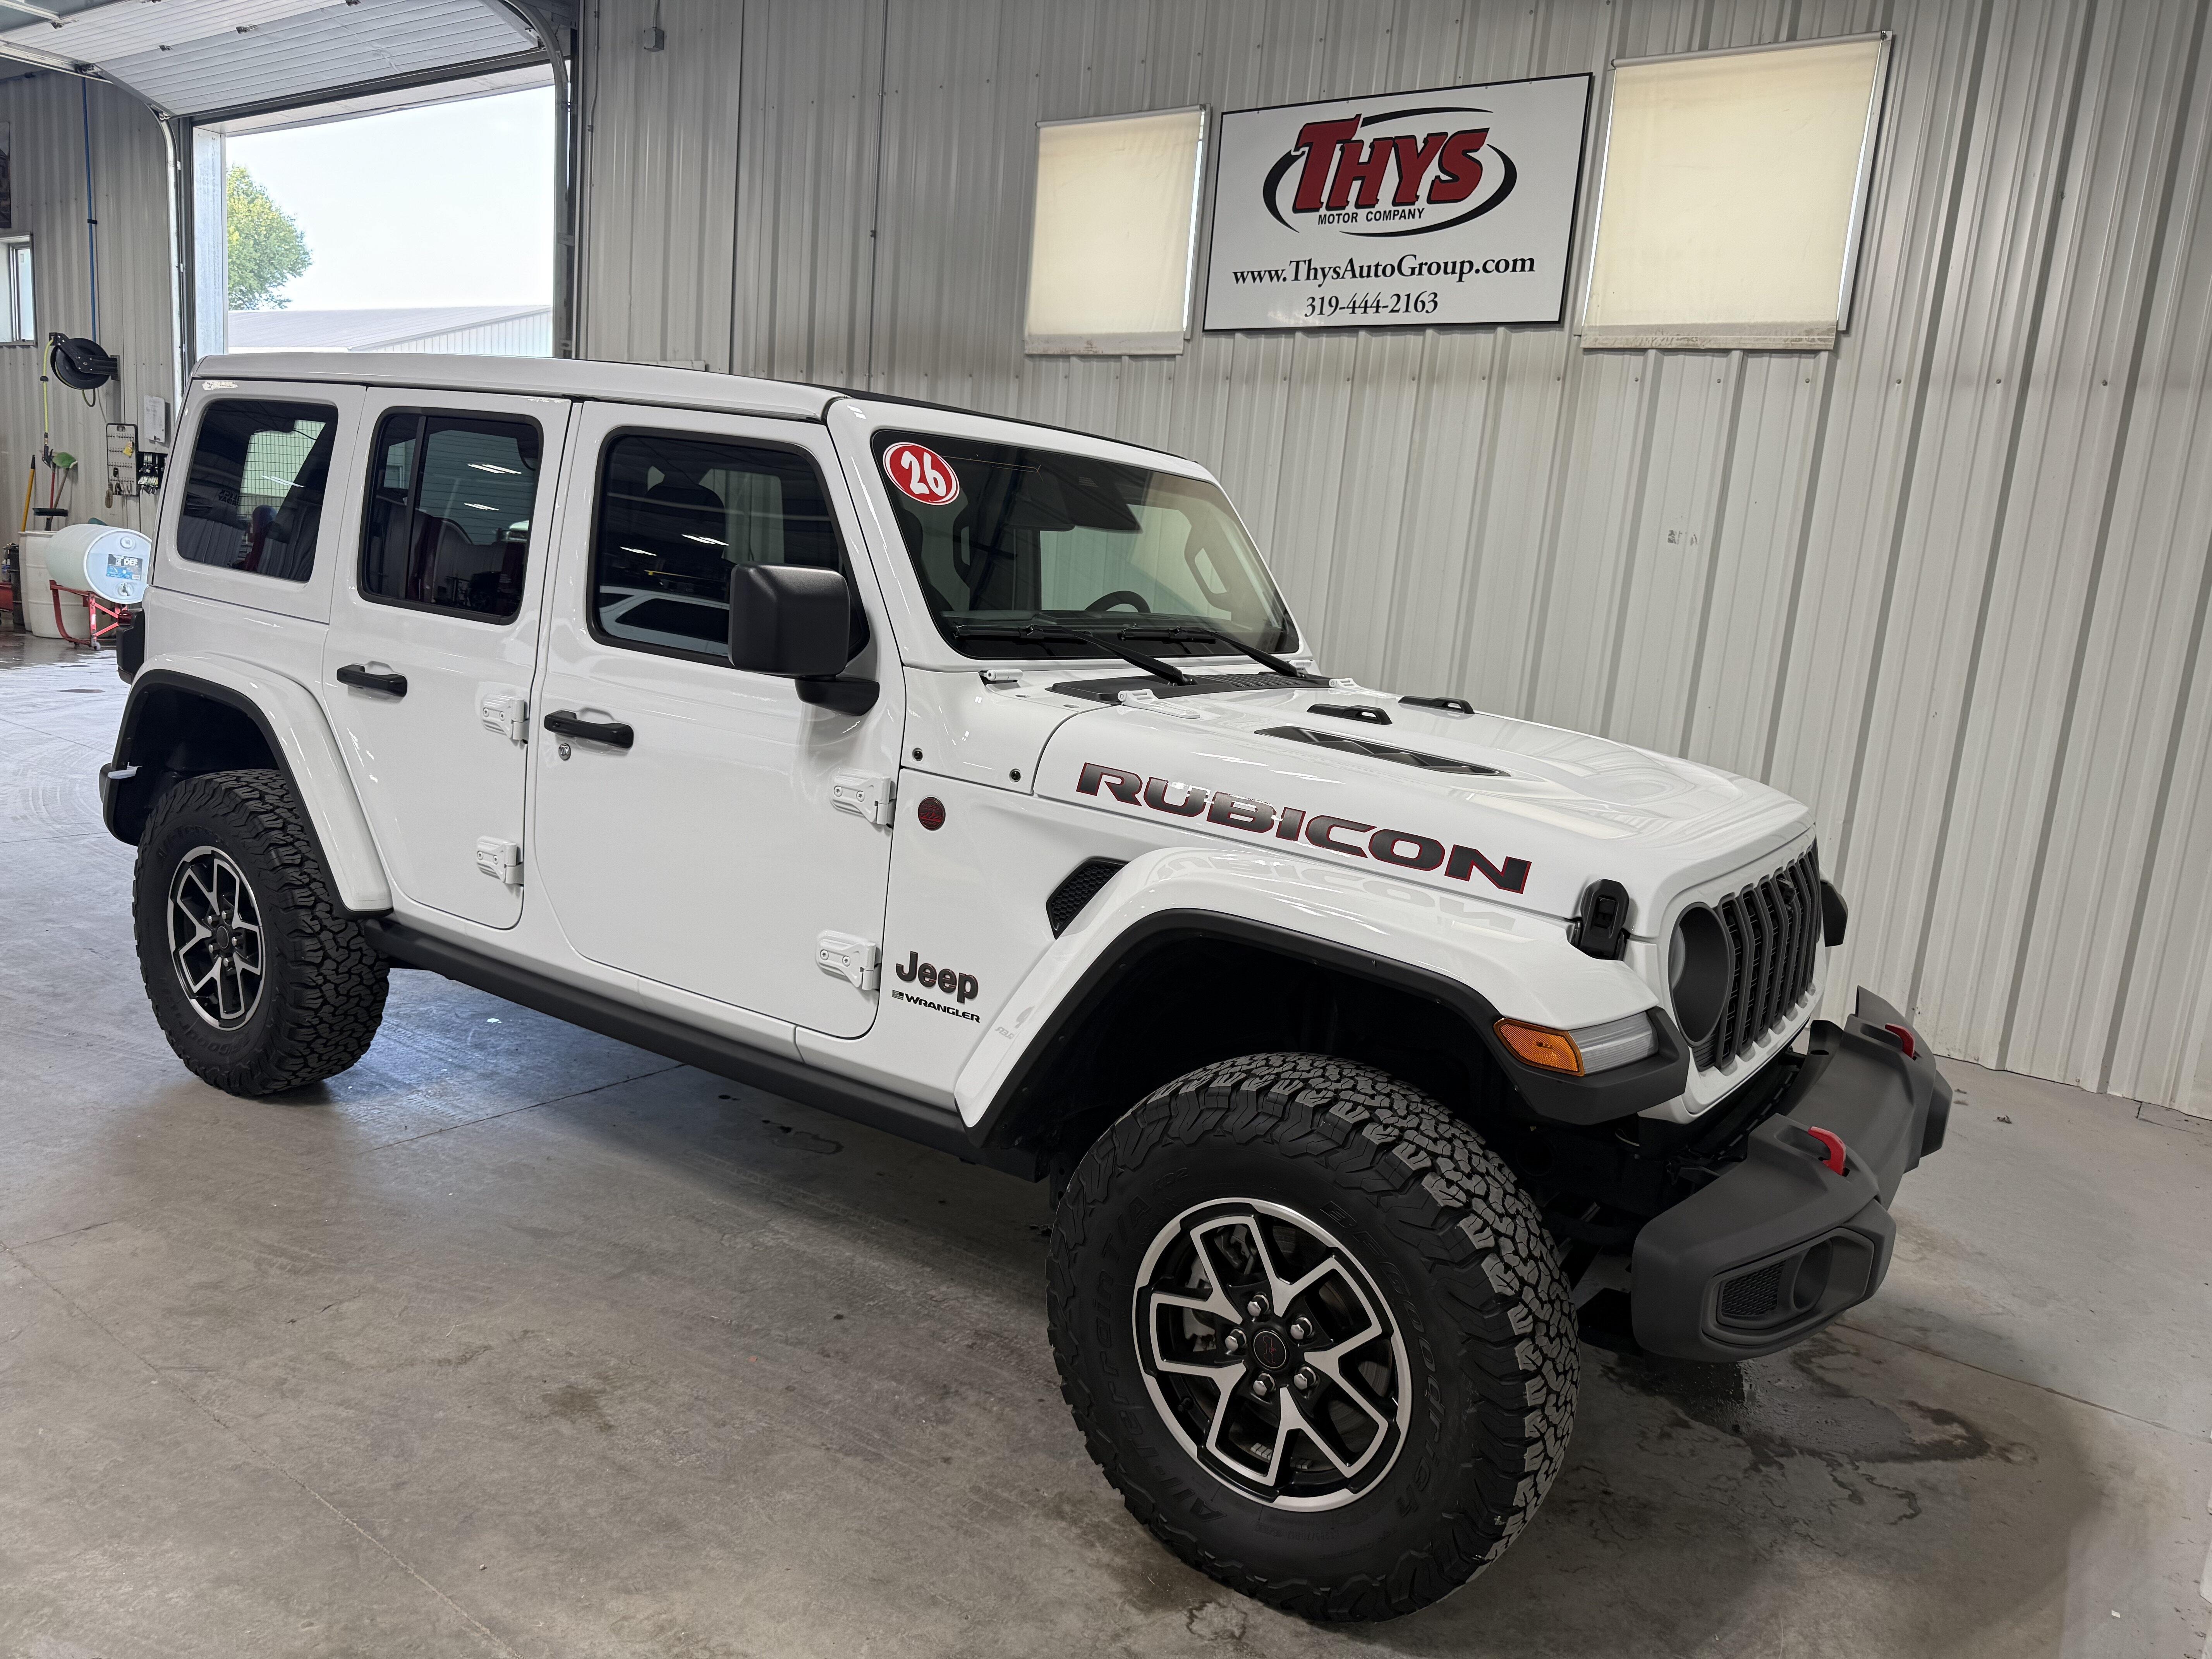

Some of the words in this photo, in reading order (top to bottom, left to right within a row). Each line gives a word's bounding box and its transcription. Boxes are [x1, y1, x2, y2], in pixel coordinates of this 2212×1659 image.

[1291, 114, 1490, 214] THYS
[1317, 211, 1358, 225] MOTOR
[1365, 207, 1425, 222] COMPANY
[1232, 254, 1535, 288] www.ThysAutoGroup.com
[1304, 291, 1439, 318] 319-444-2163
[901, 450, 947, 497] 26
[1076, 762, 1532, 894] RUBICON
[896, 951, 979, 1004] Jeep
[905, 994, 980, 1023] WRANGLER
